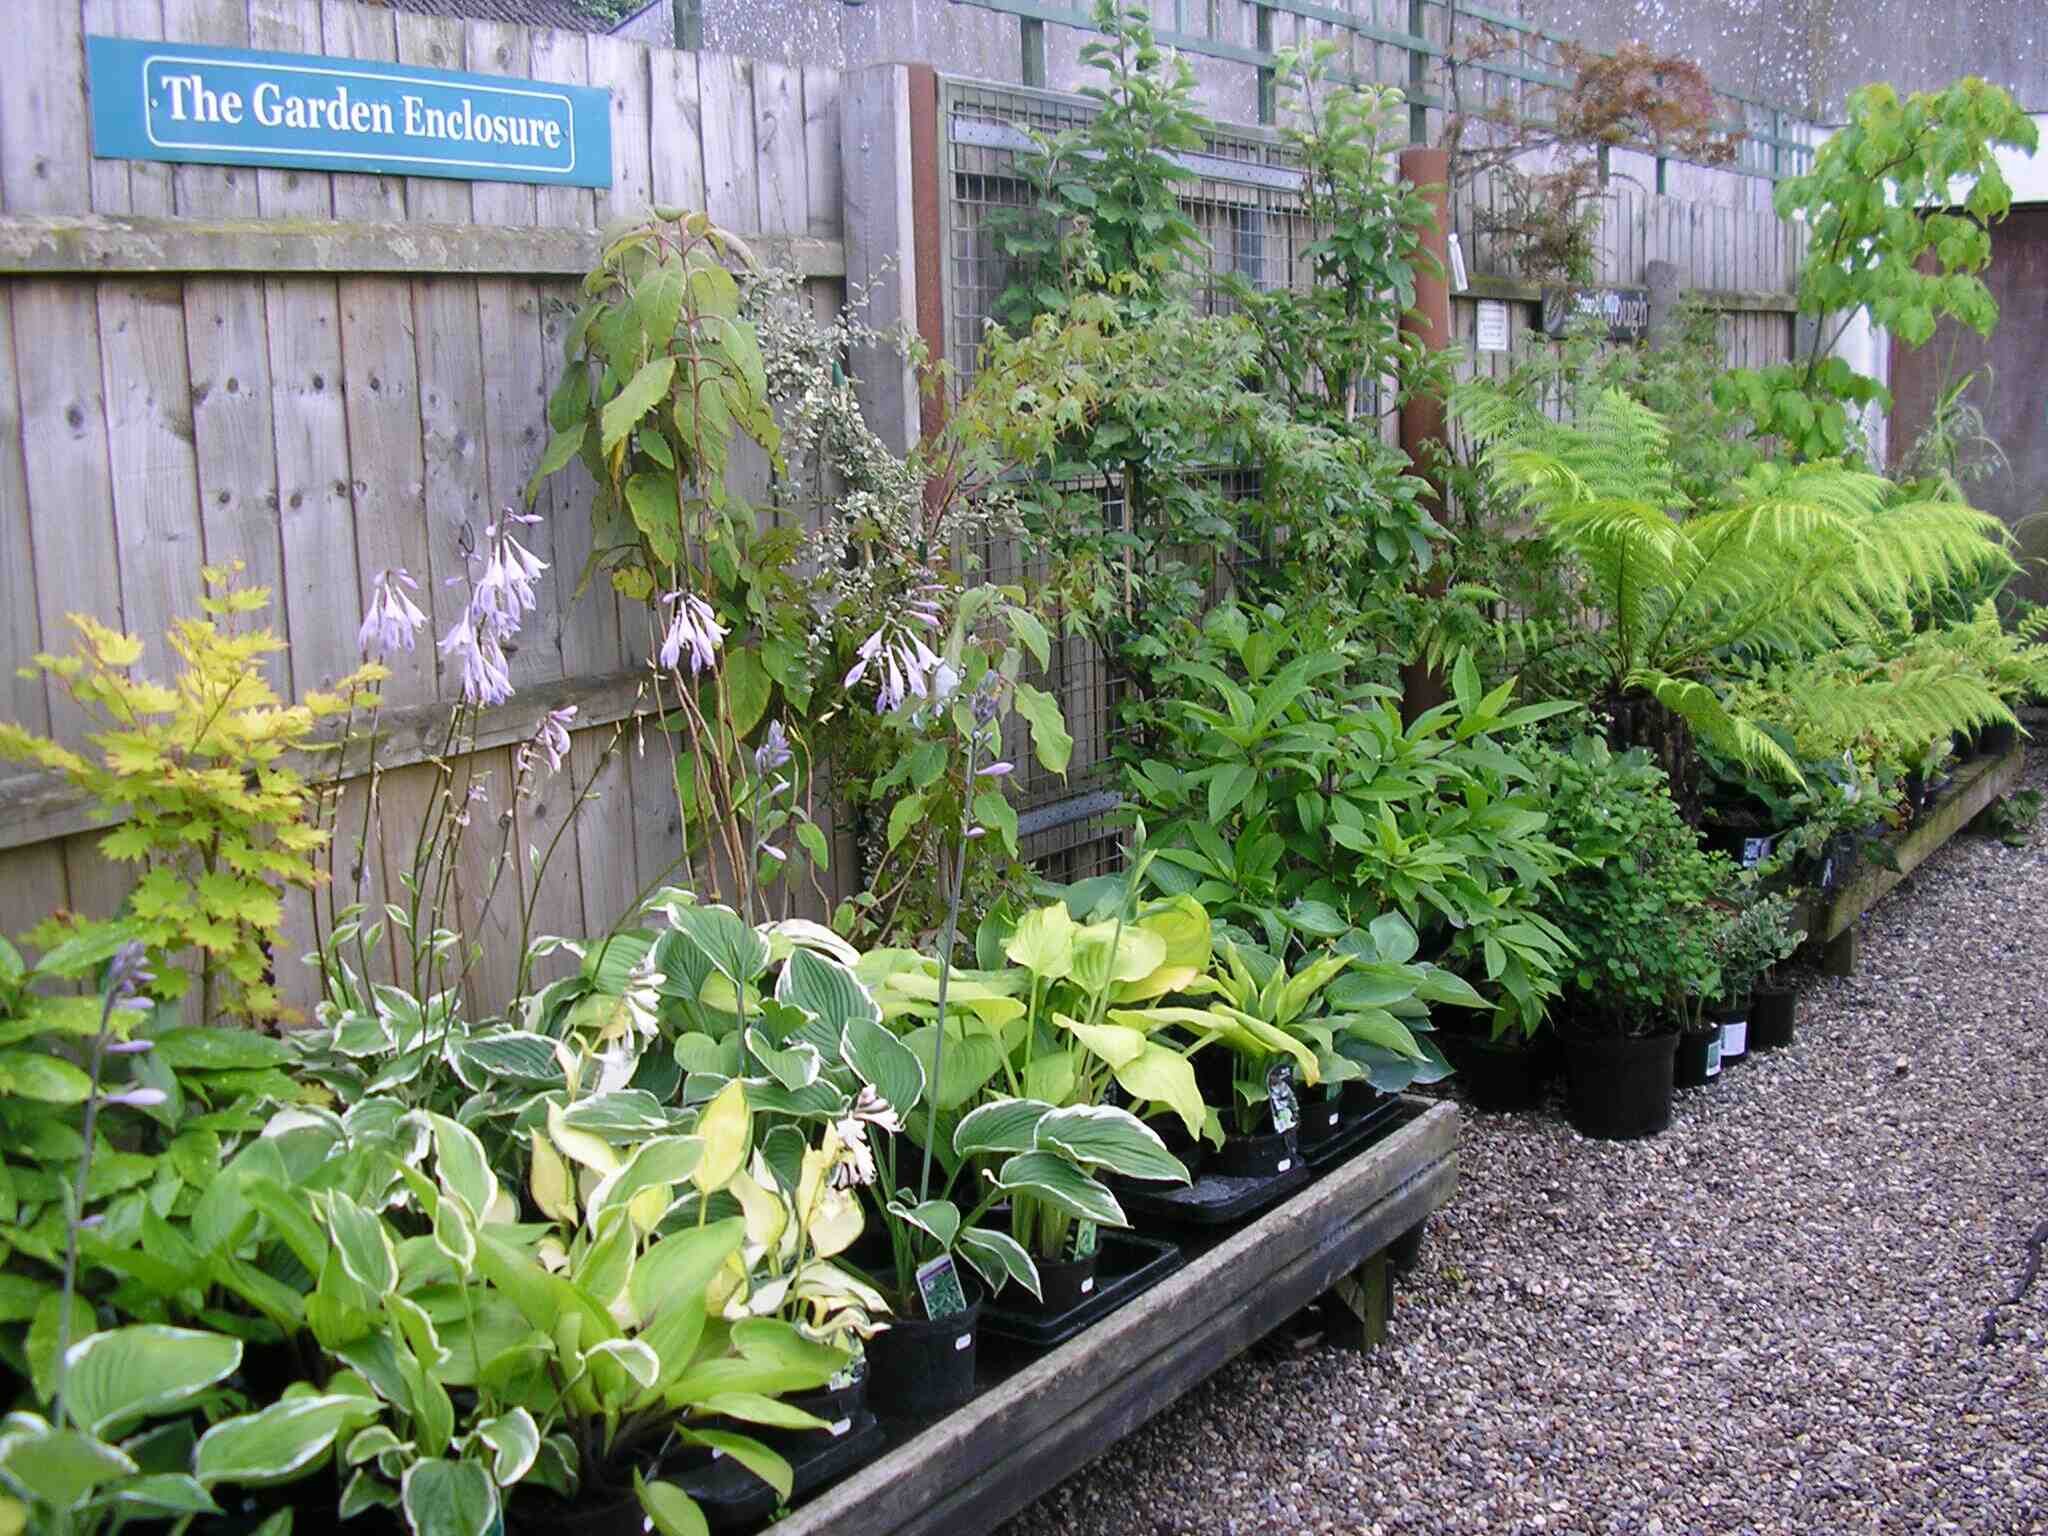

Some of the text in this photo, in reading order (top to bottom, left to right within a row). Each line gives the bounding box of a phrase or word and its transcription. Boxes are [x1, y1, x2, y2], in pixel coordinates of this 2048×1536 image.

[160, 74, 561, 149] The Garden Enclosure
